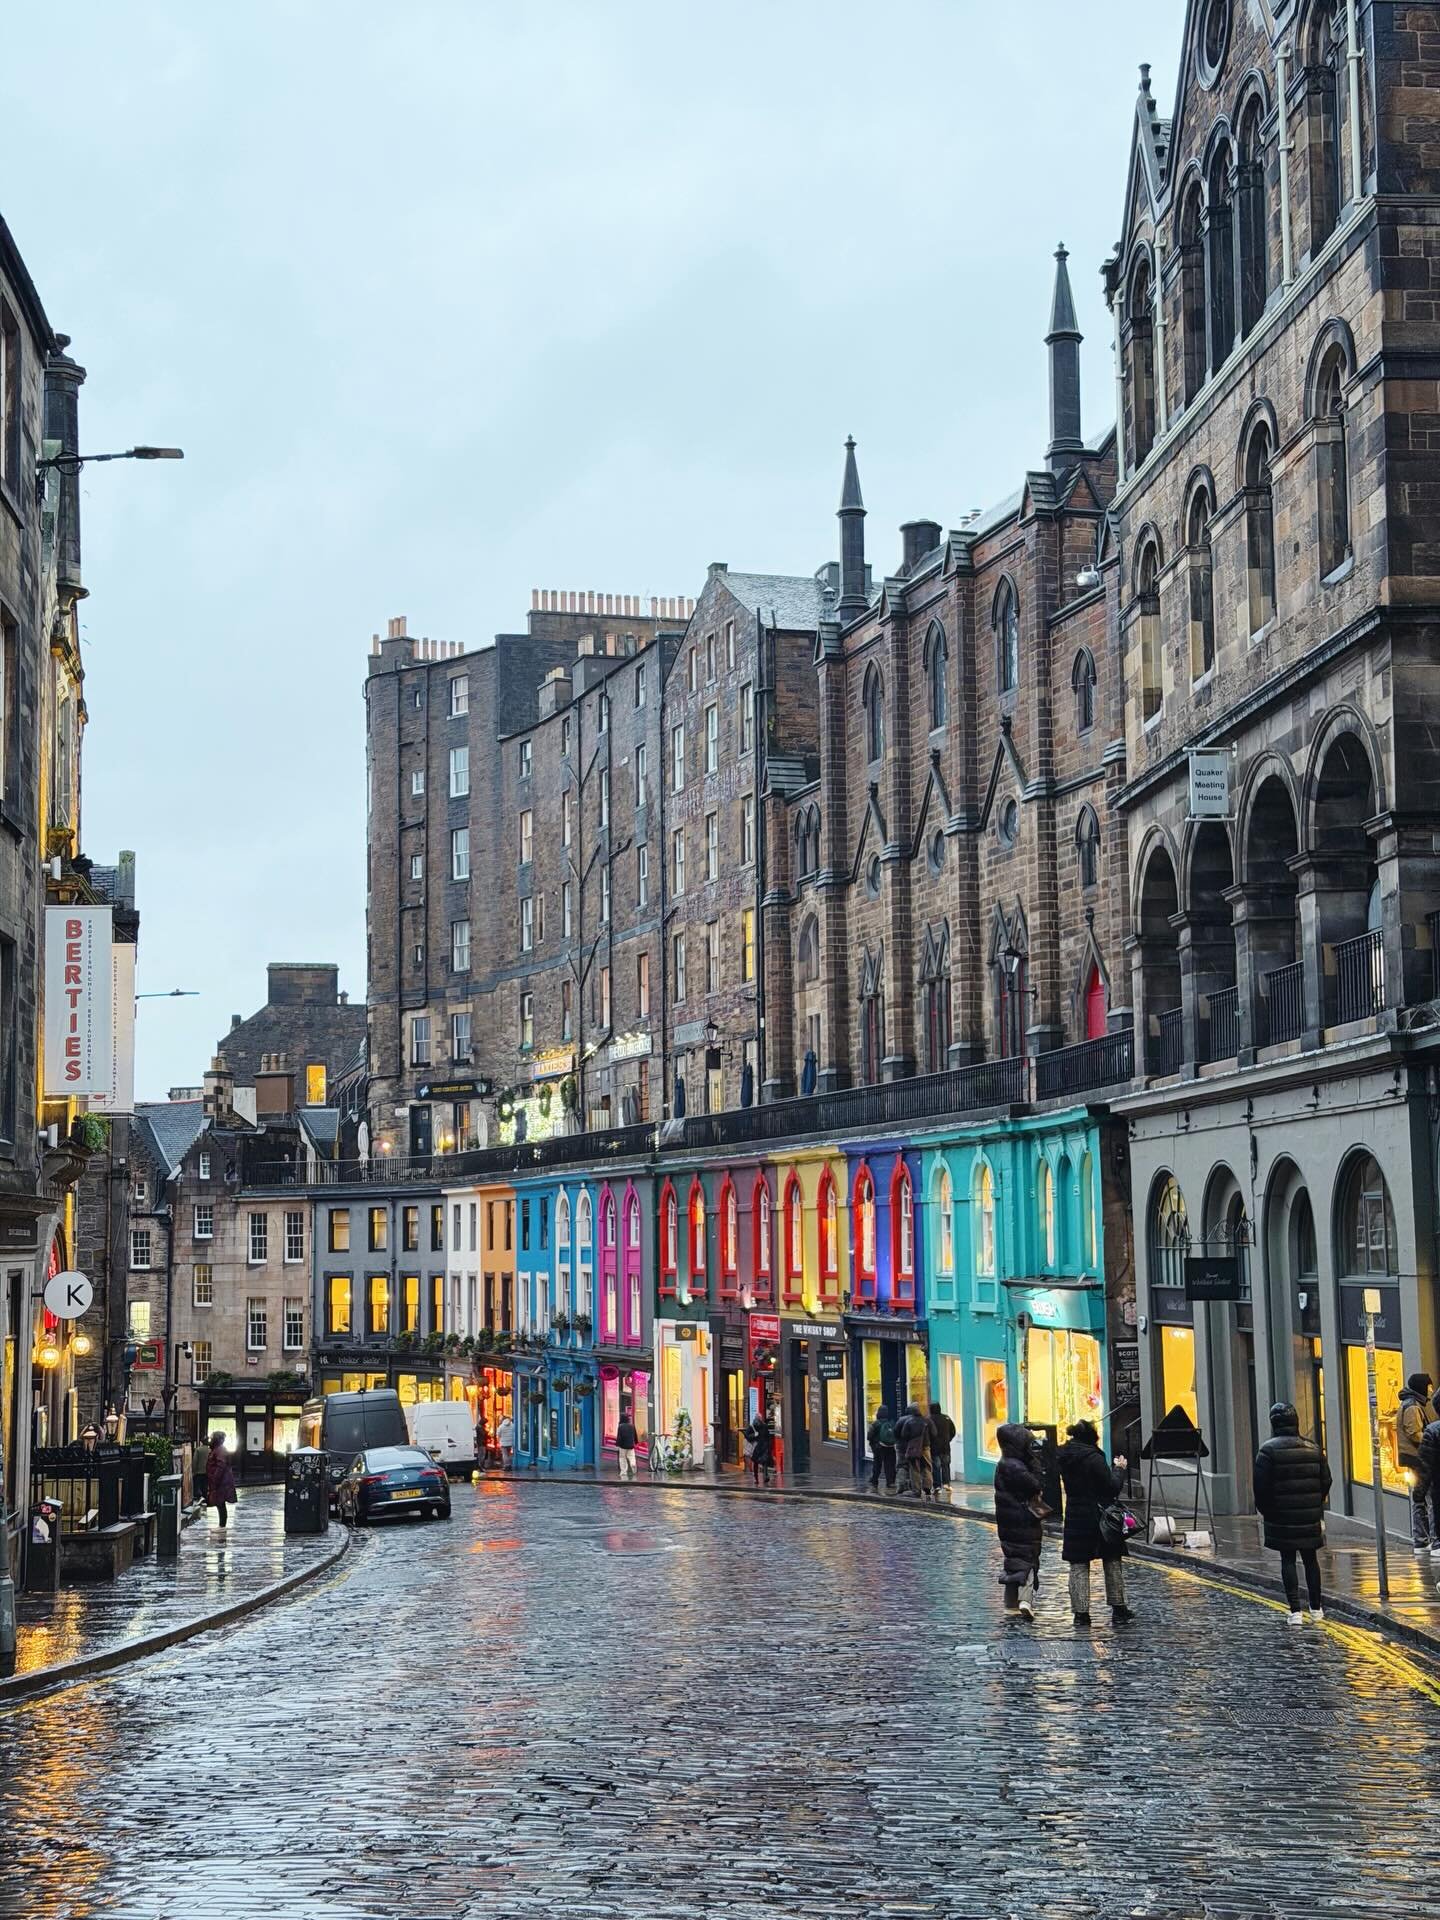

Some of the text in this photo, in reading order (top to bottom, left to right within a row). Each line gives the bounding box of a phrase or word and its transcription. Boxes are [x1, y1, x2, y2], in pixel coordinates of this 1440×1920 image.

[1195, 769, 1224, 777] Quaker
[1195, 781, 1225, 790] Meeting
[1198, 793, 1223, 801] House
[65, 919, 83, 1081] BERTIES
[67, 1284, 85, 1307] K
[792, 1323, 802, 1334] THE
[803, 1324, 822, 1336] WHISKY
[823, 1326, 837, 1337] SHOP
